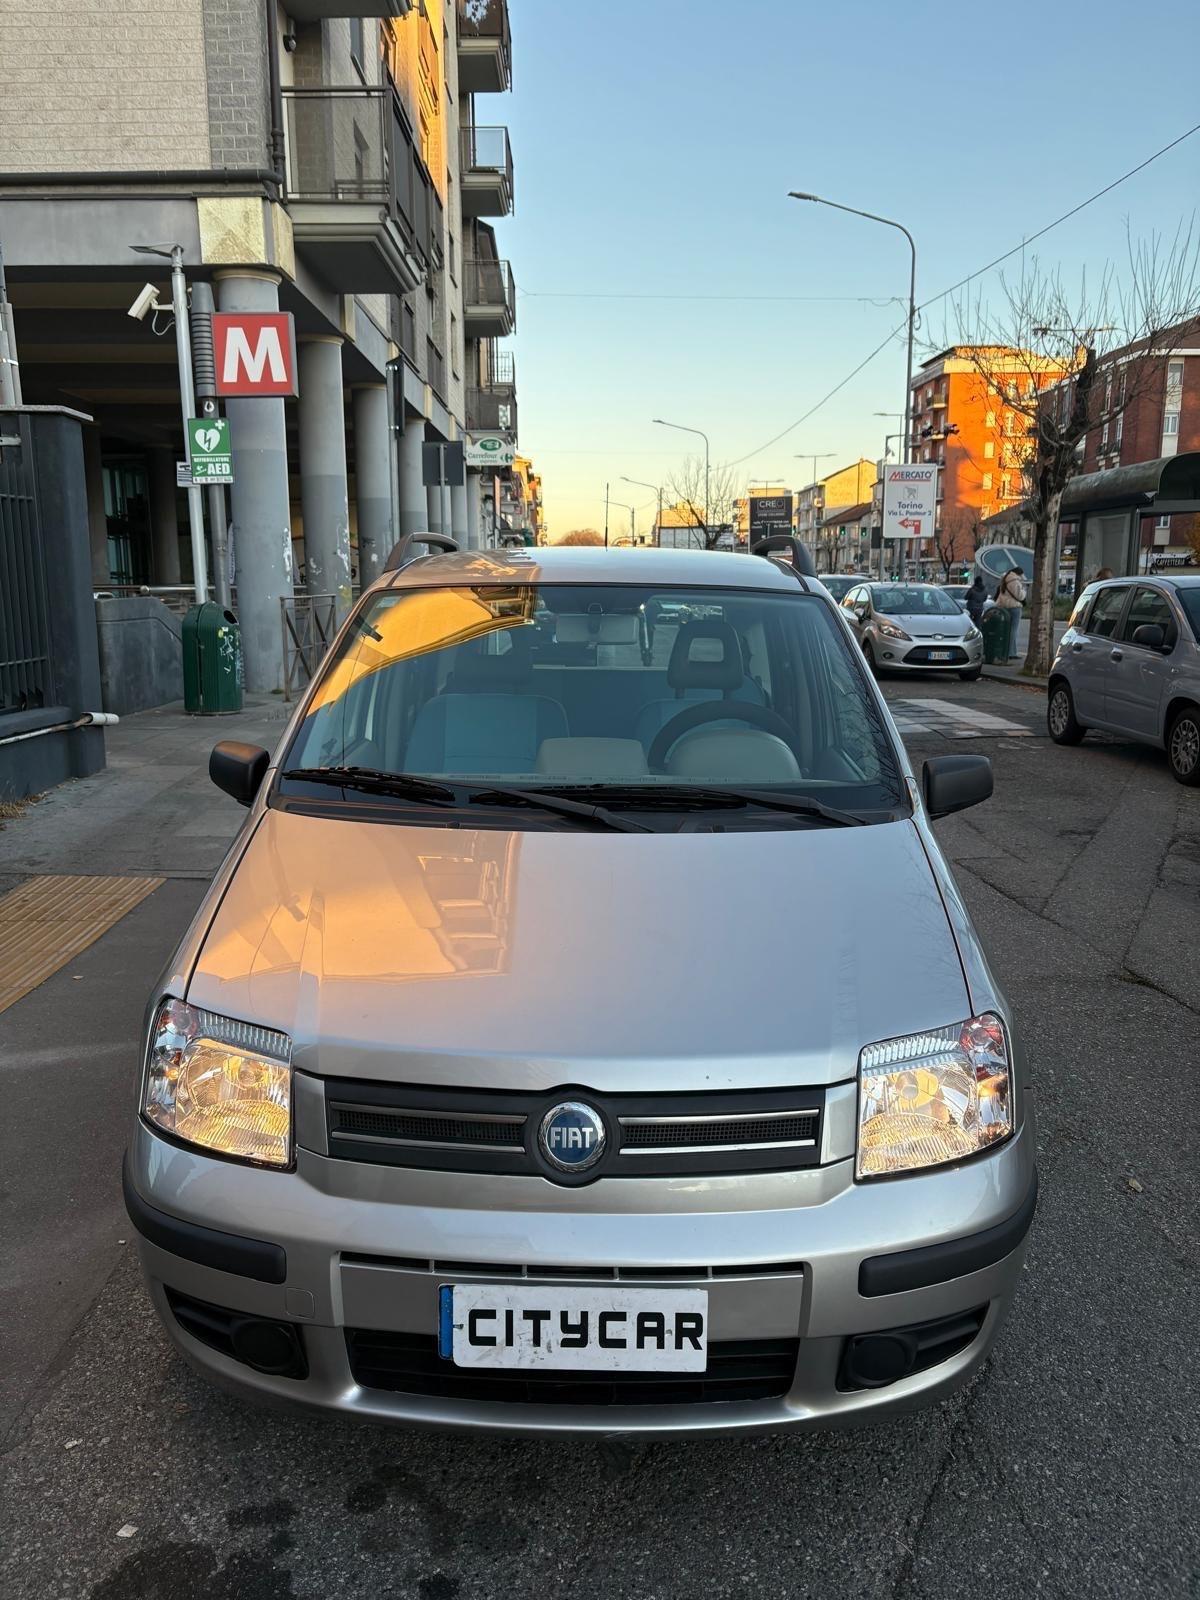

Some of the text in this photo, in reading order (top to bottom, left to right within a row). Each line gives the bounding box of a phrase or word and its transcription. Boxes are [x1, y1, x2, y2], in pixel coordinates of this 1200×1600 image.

[223, 326, 288, 383] M
[207, 463, 231, 475] AED
[898, 502, 923, 510] Torino
[550, 1127, 594, 1149] FIAT
[468, 1309, 704, 1351] CITYCAR
